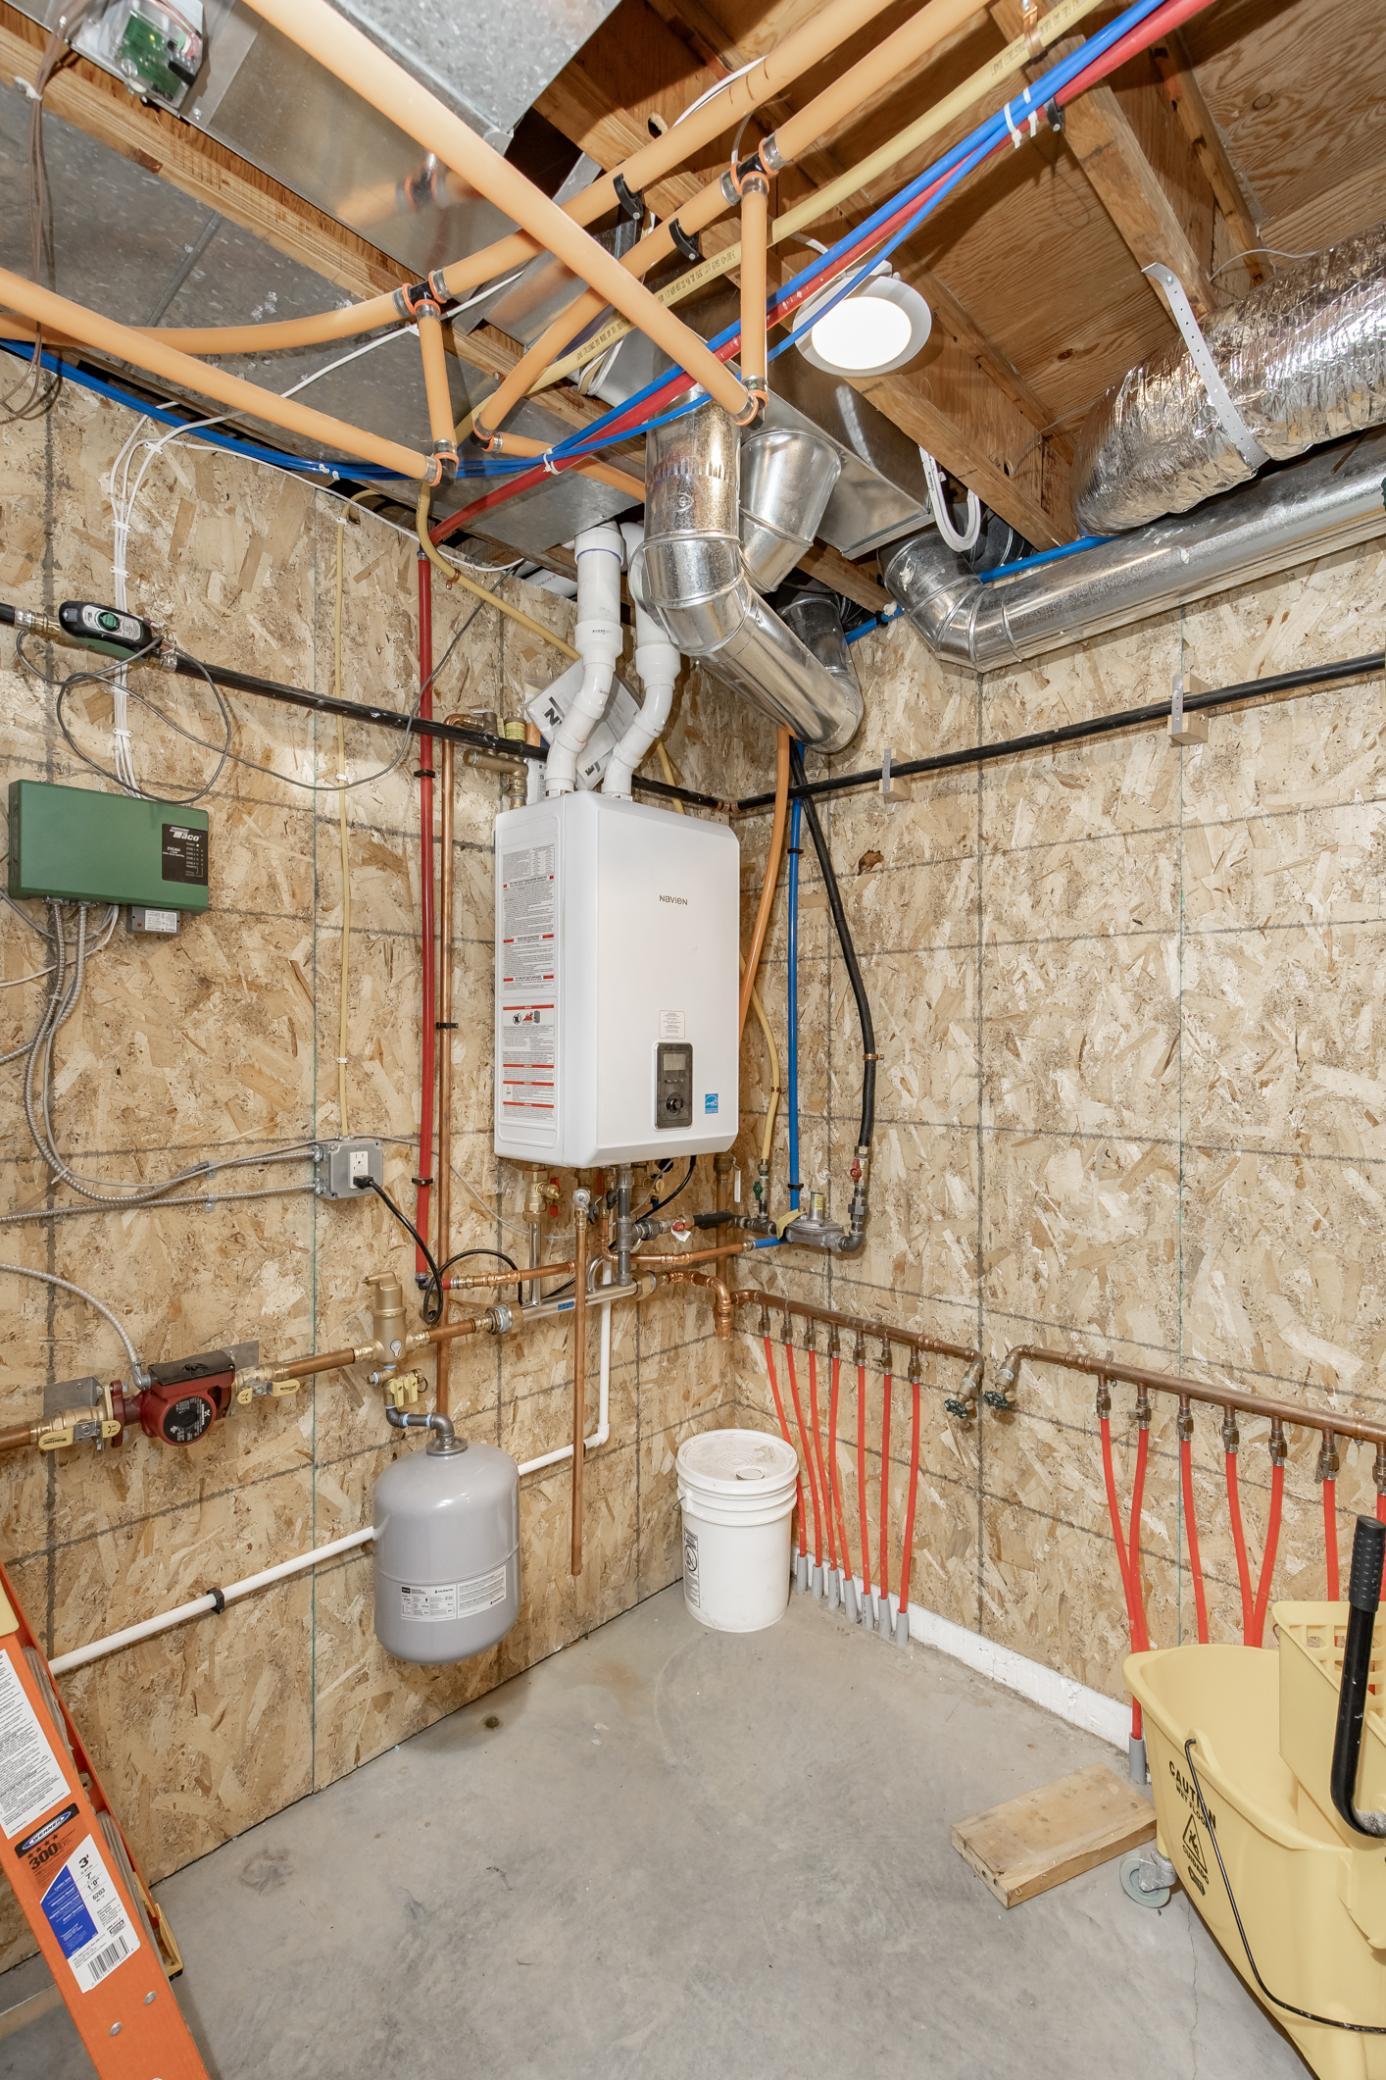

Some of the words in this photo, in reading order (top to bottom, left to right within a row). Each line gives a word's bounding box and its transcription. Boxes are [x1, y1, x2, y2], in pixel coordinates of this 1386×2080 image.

[1169, 1760, 1216, 1829] CAUTIN
[32, 1817, 62, 1843] WERNER
[29, 1842, 58, 1870] 300
